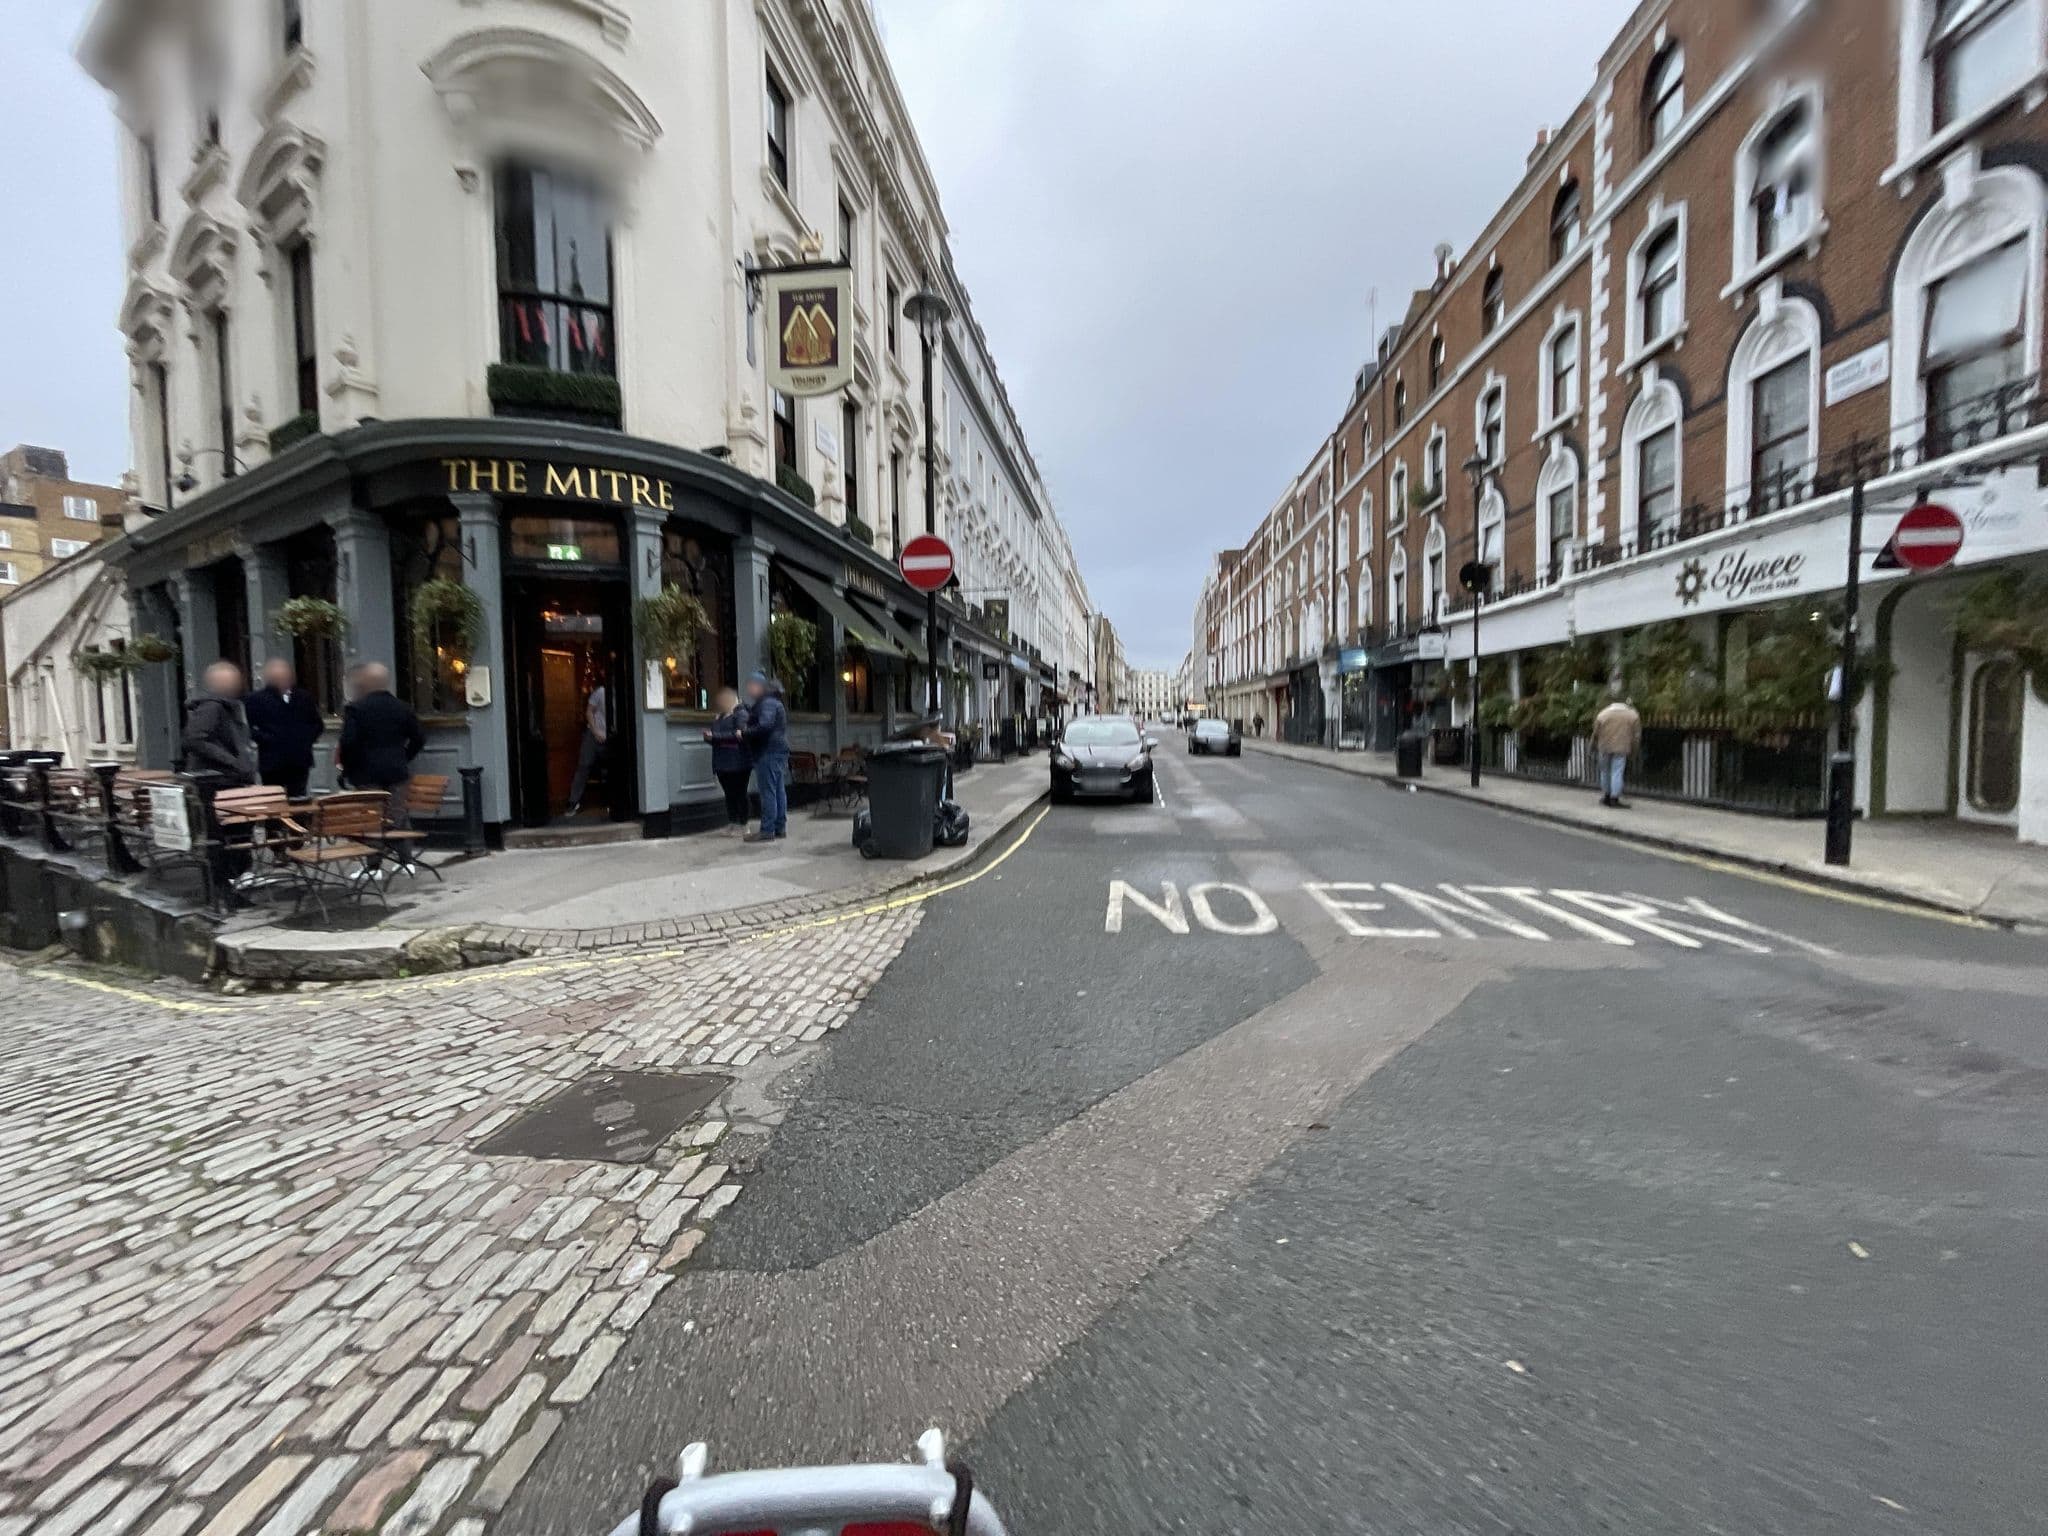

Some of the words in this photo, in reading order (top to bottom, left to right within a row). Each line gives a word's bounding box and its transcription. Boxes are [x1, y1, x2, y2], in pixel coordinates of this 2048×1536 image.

[442, 459, 528, 494] THE
[543, 463, 674, 511] MITRE
[1711, 548, 1806, 599] Elysee
[1106, 880, 1278, 935] NO
[1302, 881, 1842, 959] ENTRY
